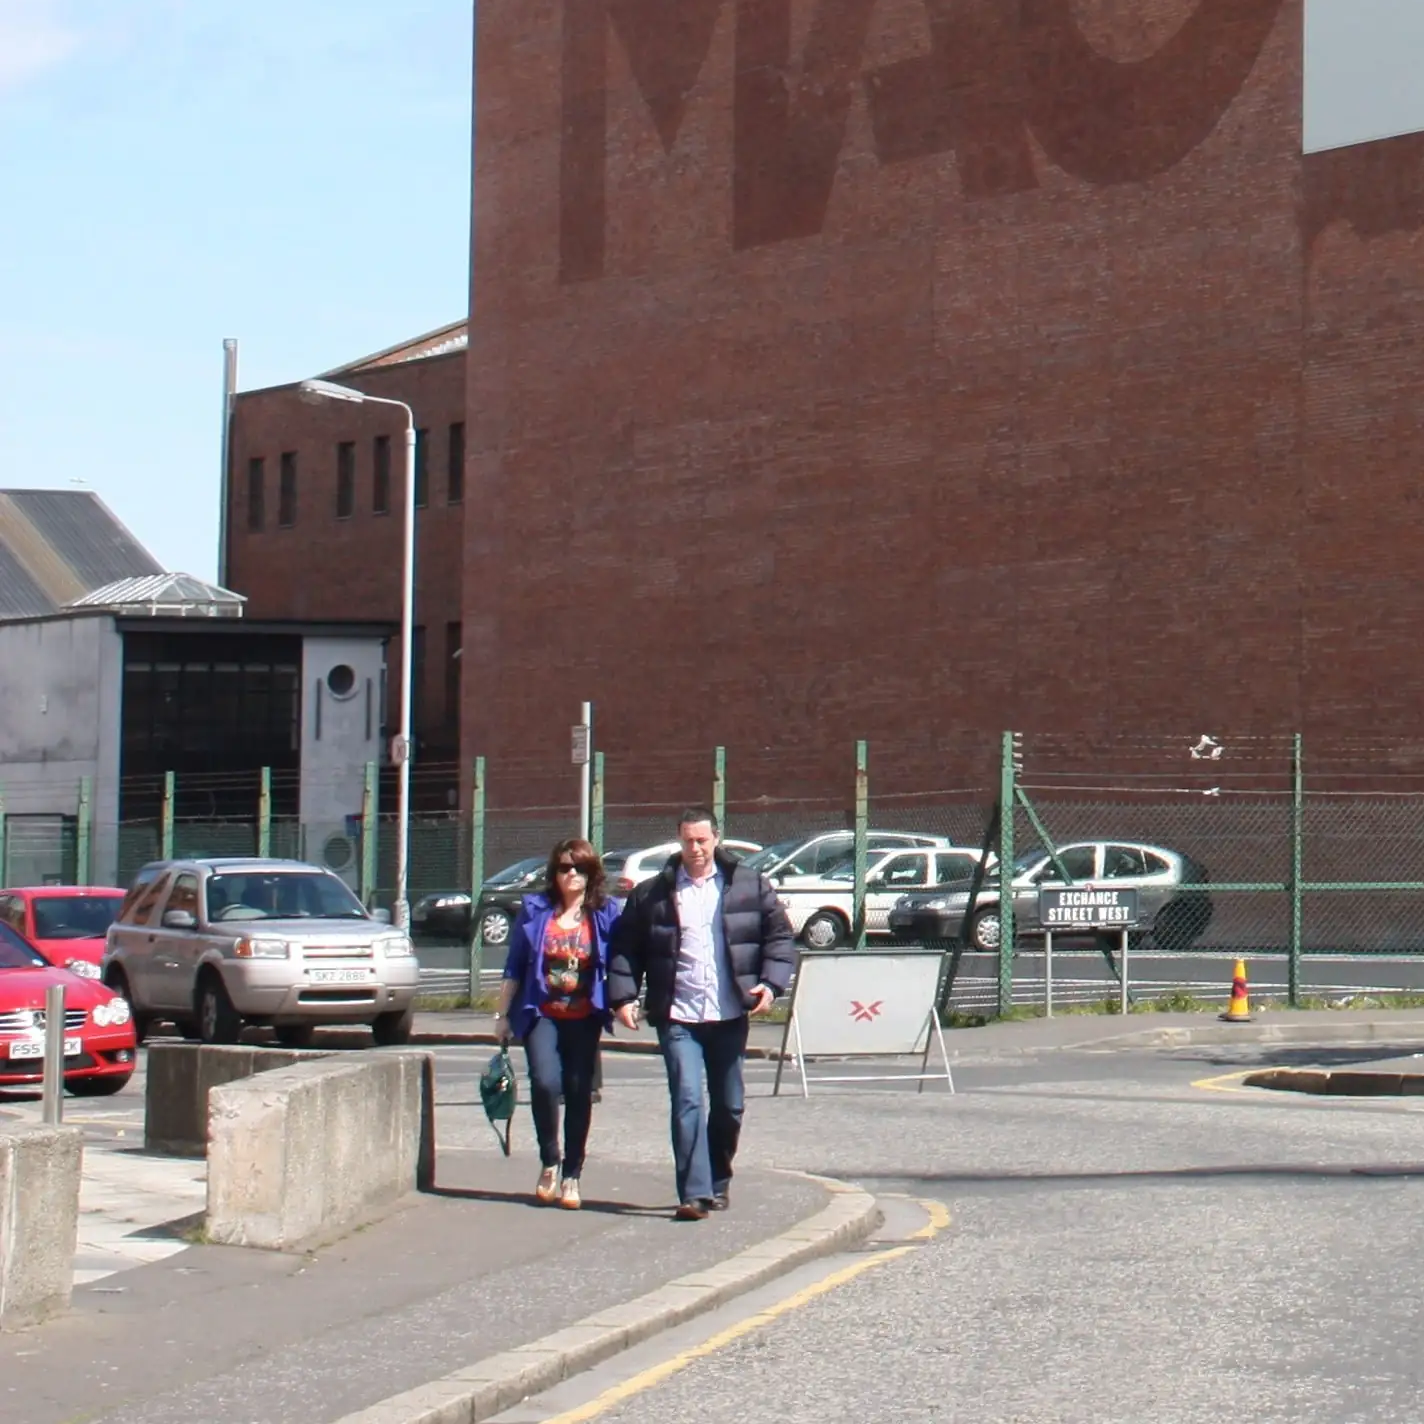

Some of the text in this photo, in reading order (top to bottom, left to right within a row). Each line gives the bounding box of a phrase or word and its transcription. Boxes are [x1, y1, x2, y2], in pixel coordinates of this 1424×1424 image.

[1059, 891, 1119, 906] EXCHANGE
[1048, 906, 1129, 921] STREET WEST
